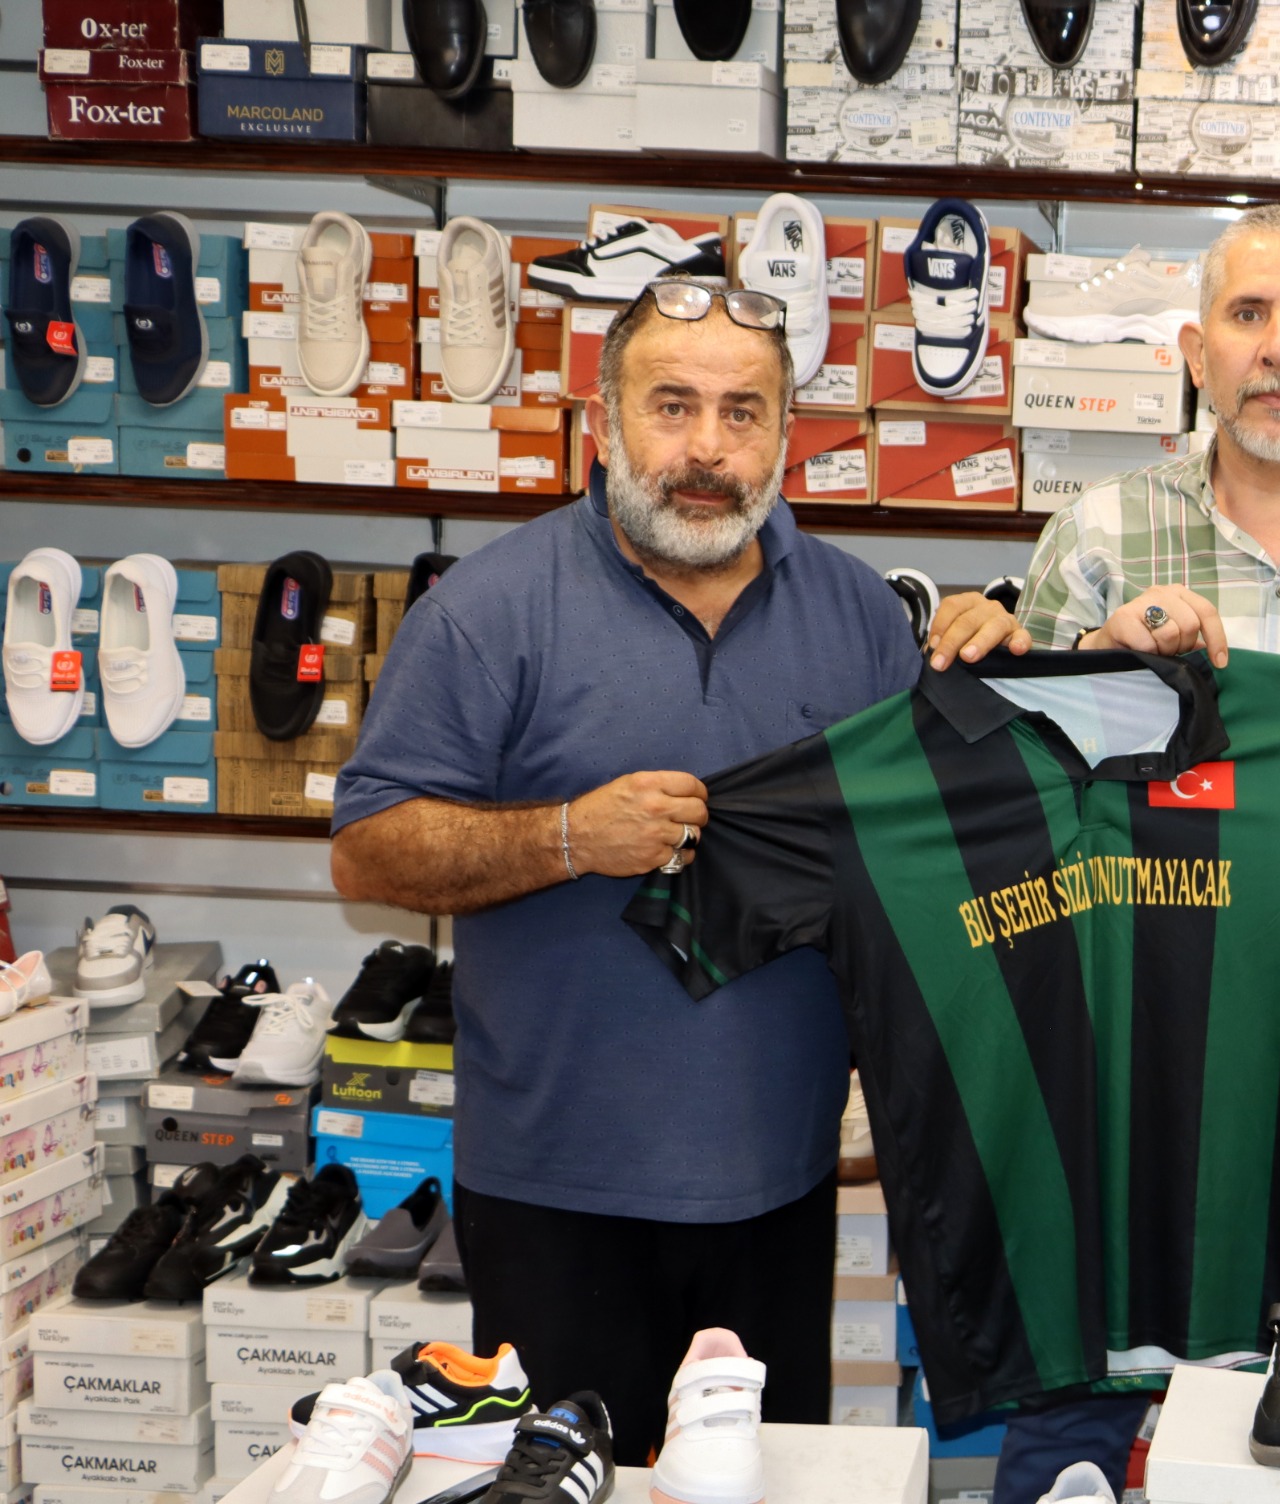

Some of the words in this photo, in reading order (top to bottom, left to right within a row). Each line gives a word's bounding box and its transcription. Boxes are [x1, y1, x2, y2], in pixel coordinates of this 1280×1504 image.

[119, 55, 164, 69] Fox-ter
[68, 96, 165, 125] Fox-ter
[227, 105, 323, 122] MARCOLAND
[849, 113, 891, 126] CONTEYNER
[1014, 111, 1071, 128] CONTEYNER
[1201, 121, 1245, 135] CONTEYNER
[241, 123, 312, 134] EXCLUSIVE
[767, 260, 797, 278] VANS
[927, 257, 956, 280] VANS
[1024, 393, 1075, 409] QUEEN
[1078, 397, 1116, 412] STEP
[809, 454, 834, 466] VANS
[954, 457, 980, 470] VANS
[984, 452, 1008, 463] Hylane
[409, 468, 495, 480] LAMBIRLENT
[1033, 480, 1082, 494] QUEEN
[959, 895, 995, 948] BU
[990, 870, 1057, 949] ŞEHİR
[1052, 850, 1092, 917] SİZİ
[155, 1128, 199, 1142] QUEEN
[201, 1132, 236, 1146] STEP
[212, 1306, 245, 1316] Türkiye
[236, 1347, 337, 1367] ÇAKMAKLAR
[257, 1366, 296, 1376] Ayakkabı
[298, 1368, 315, 1376] Park
[63, 1375, 161, 1395] ÇAKMAKLAR
[84, 1395, 122, 1404] Ayakkabı
[123, 1396, 141, 1405] Park
[342, 1391, 382, 1410] adidas
[533, 1419, 569, 1434] adidas
[61, 1454, 157, 1473] ÇAKMAKLAR
[81, 1473, 118, 1483] Ayakkabı
[120, 1475, 137, 1484] Park
